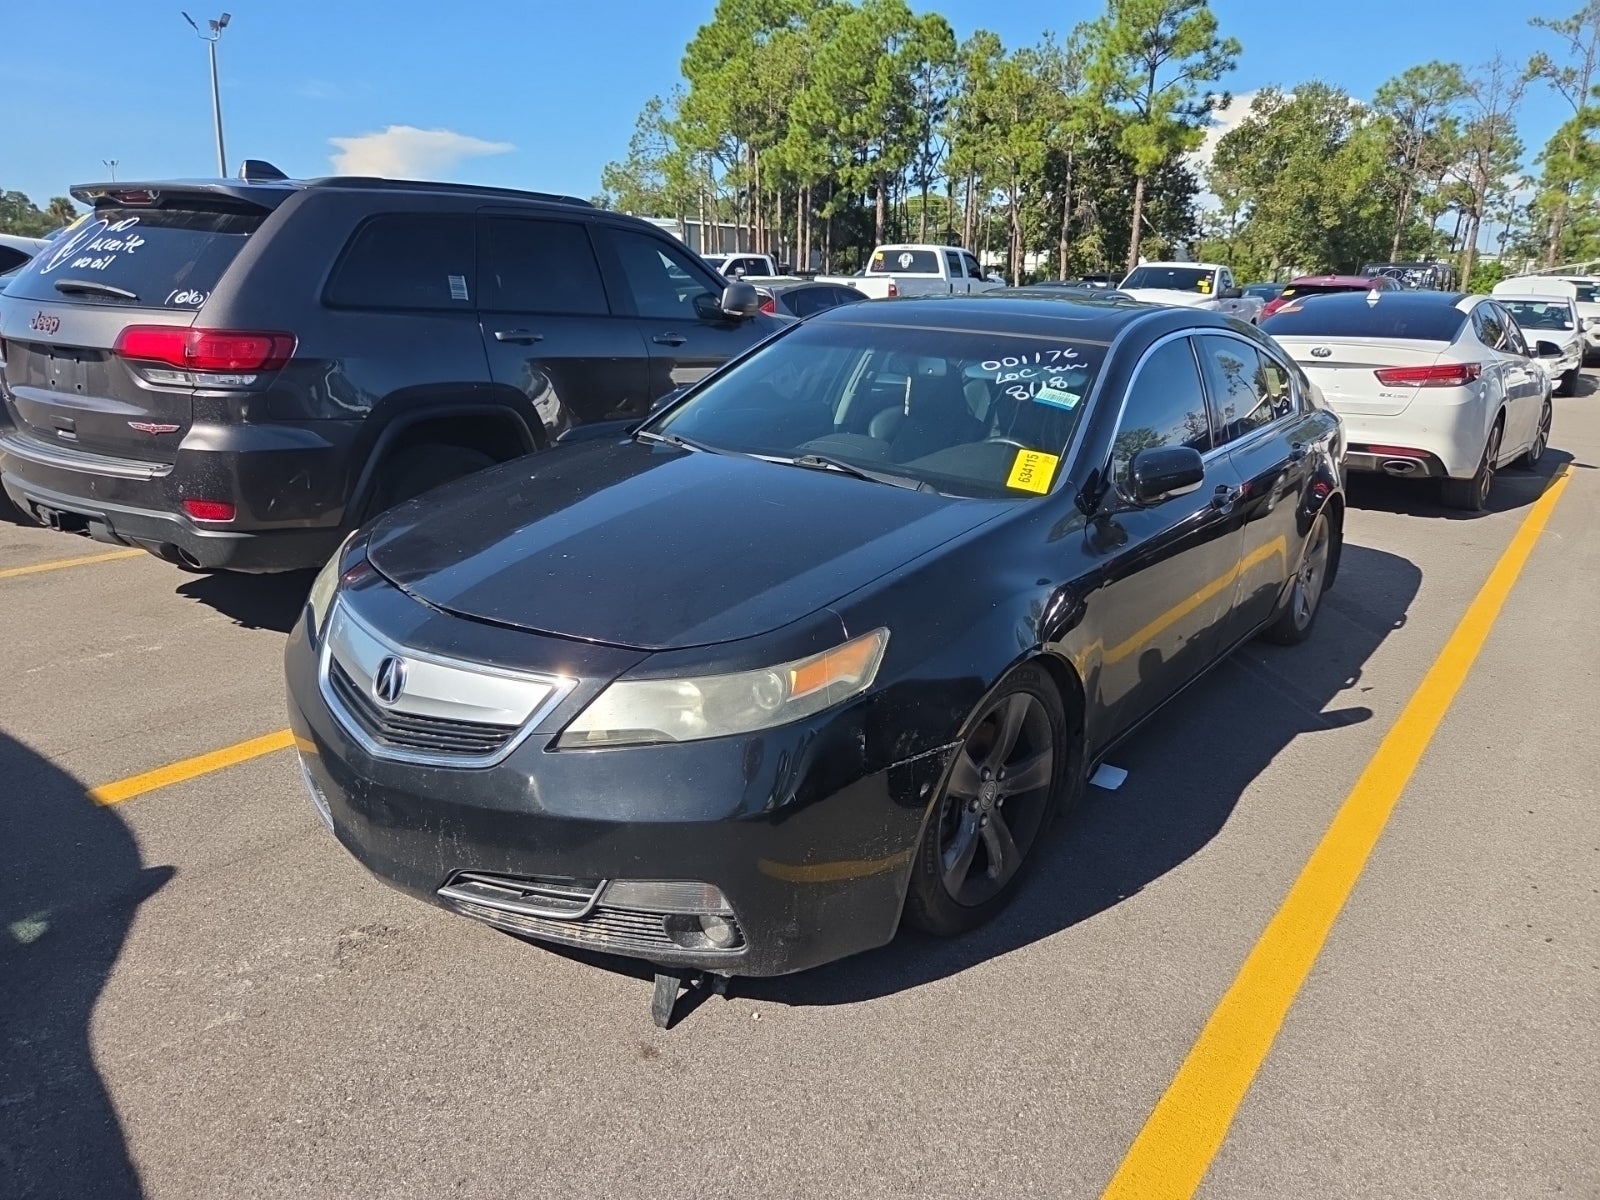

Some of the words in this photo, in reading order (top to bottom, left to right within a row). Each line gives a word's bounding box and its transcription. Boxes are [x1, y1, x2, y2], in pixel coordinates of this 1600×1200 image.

[29, 311, 61, 336] Jeep
[981, 348, 1079, 371] 001176
[1312, 347, 1330, 357] KIA
[1018, 453, 1040, 483] 634115
